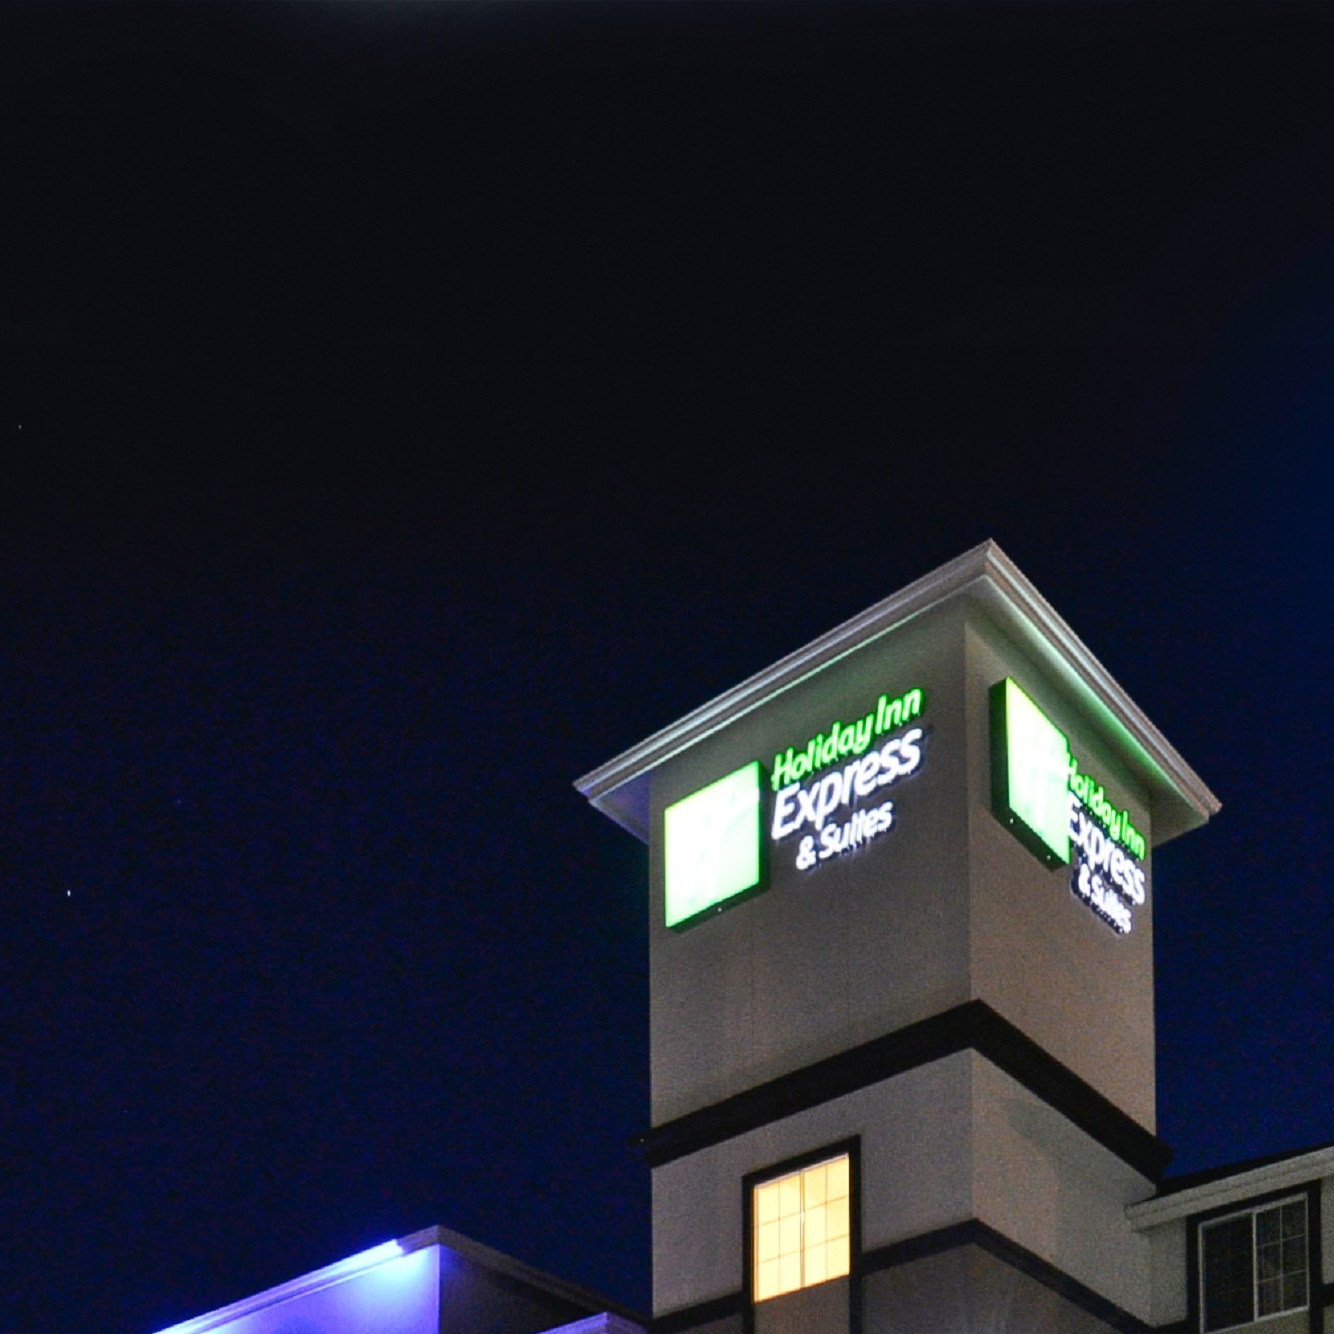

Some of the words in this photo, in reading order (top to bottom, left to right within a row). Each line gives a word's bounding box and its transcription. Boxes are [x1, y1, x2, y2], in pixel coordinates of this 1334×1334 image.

[770, 713, 875, 792] Holiday
[874, 687, 923, 736] Inn
[770, 728, 924, 841] Express
[795, 834, 817, 871] &
[818, 801, 895, 860] Suites
[1067, 753, 1122, 841] Holiday
[1121, 808, 1146, 861] Inn
[1067, 789, 1146, 906] Express
[1078, 862, 1091, 898] &
[1090, 874, 1132, 935] Suites
